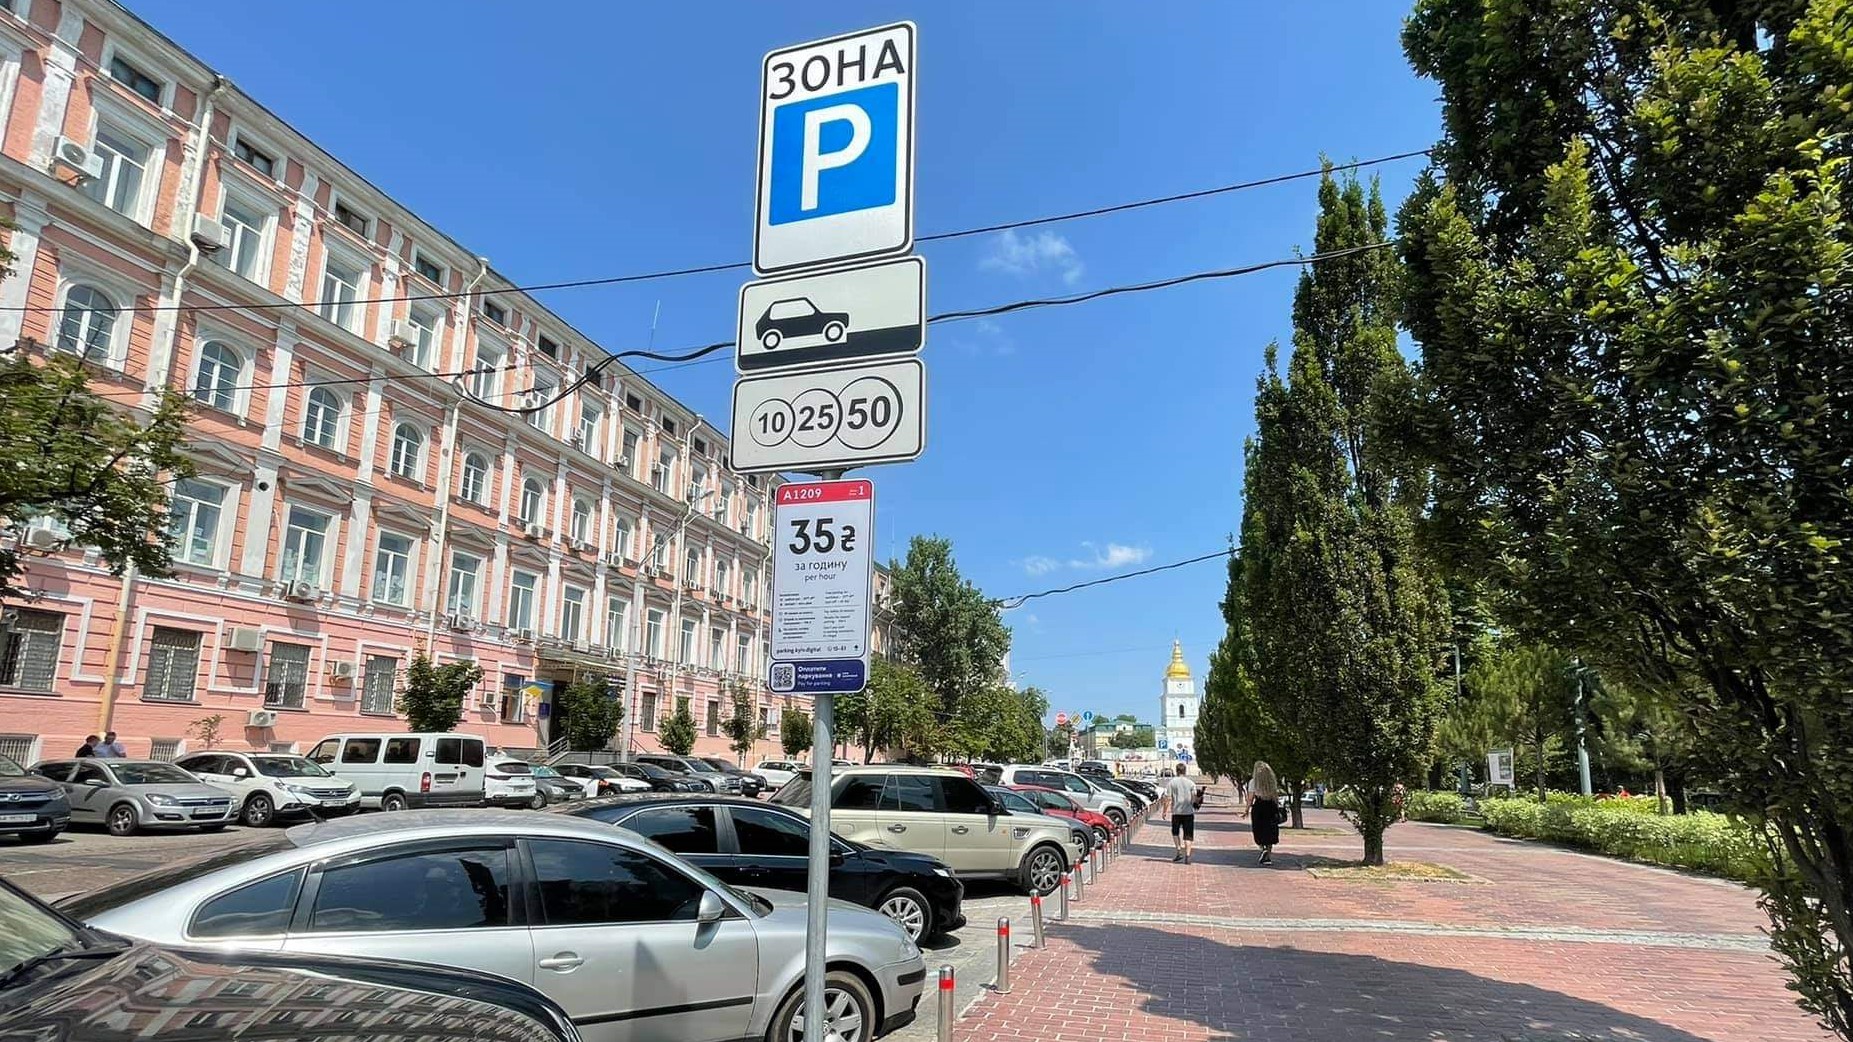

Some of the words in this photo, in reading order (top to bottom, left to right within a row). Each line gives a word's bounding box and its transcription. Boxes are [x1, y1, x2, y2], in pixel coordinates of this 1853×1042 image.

[769, 38, 905, 100] ЗОНА
[801, 103, 872, 212] P
[758, 411, 785, 434] 10
[798, 404, 834, 432] 25
[847, 395, 891, 430] 50
[783, 489, 822, 500] A1209
[794, 562, 806, 571] за
[809, 560, 848, 571] годину
[804, 574, 817, 582] per
